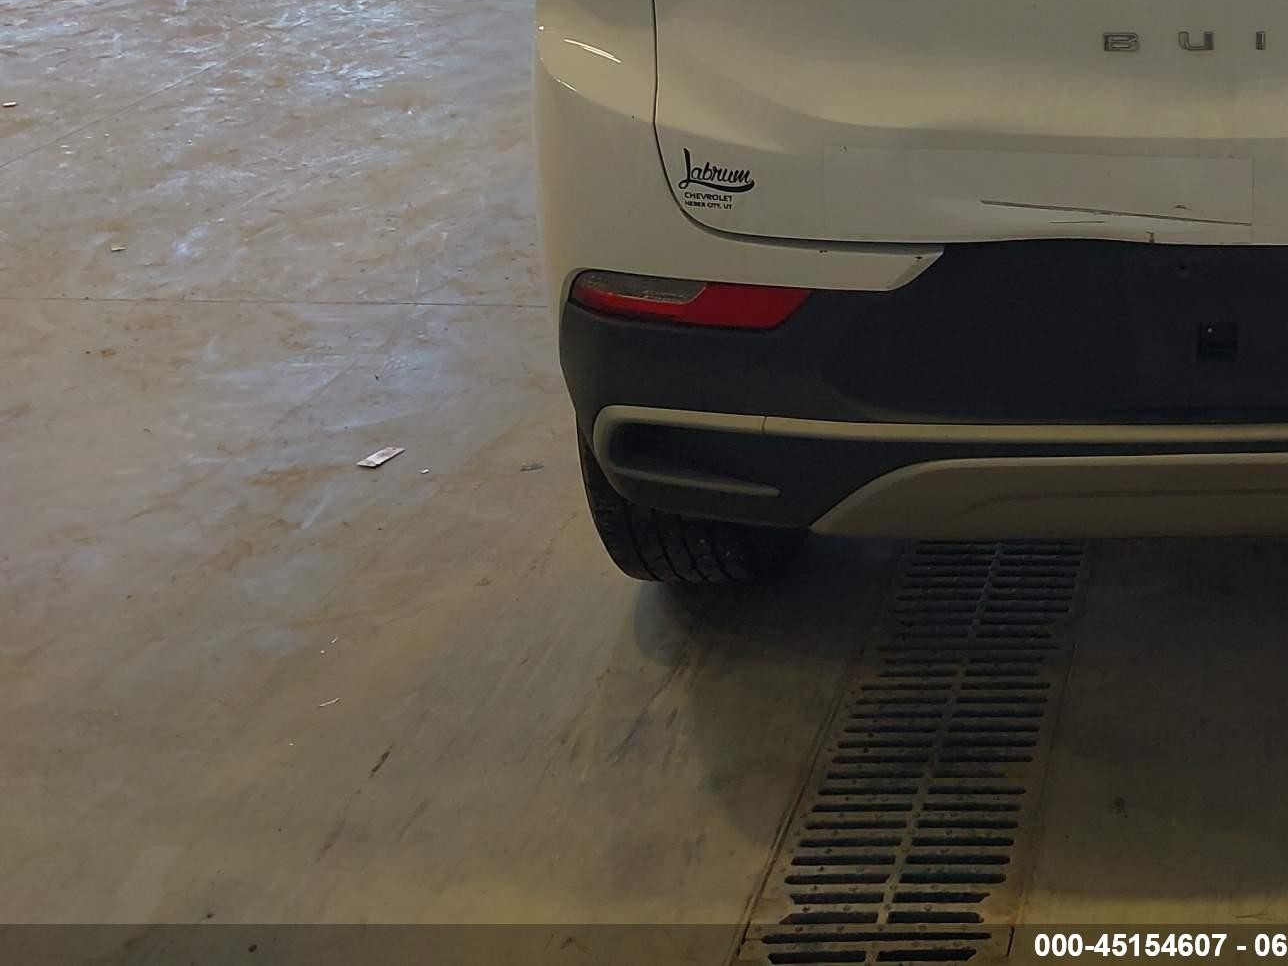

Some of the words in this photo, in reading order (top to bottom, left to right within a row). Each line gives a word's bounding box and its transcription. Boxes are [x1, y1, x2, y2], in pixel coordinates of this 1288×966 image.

[679, 147, 755, 193] Labrum
[684, 192, 733, 202] CHEVROLET
[685, 200, 706, 208] HEBER
